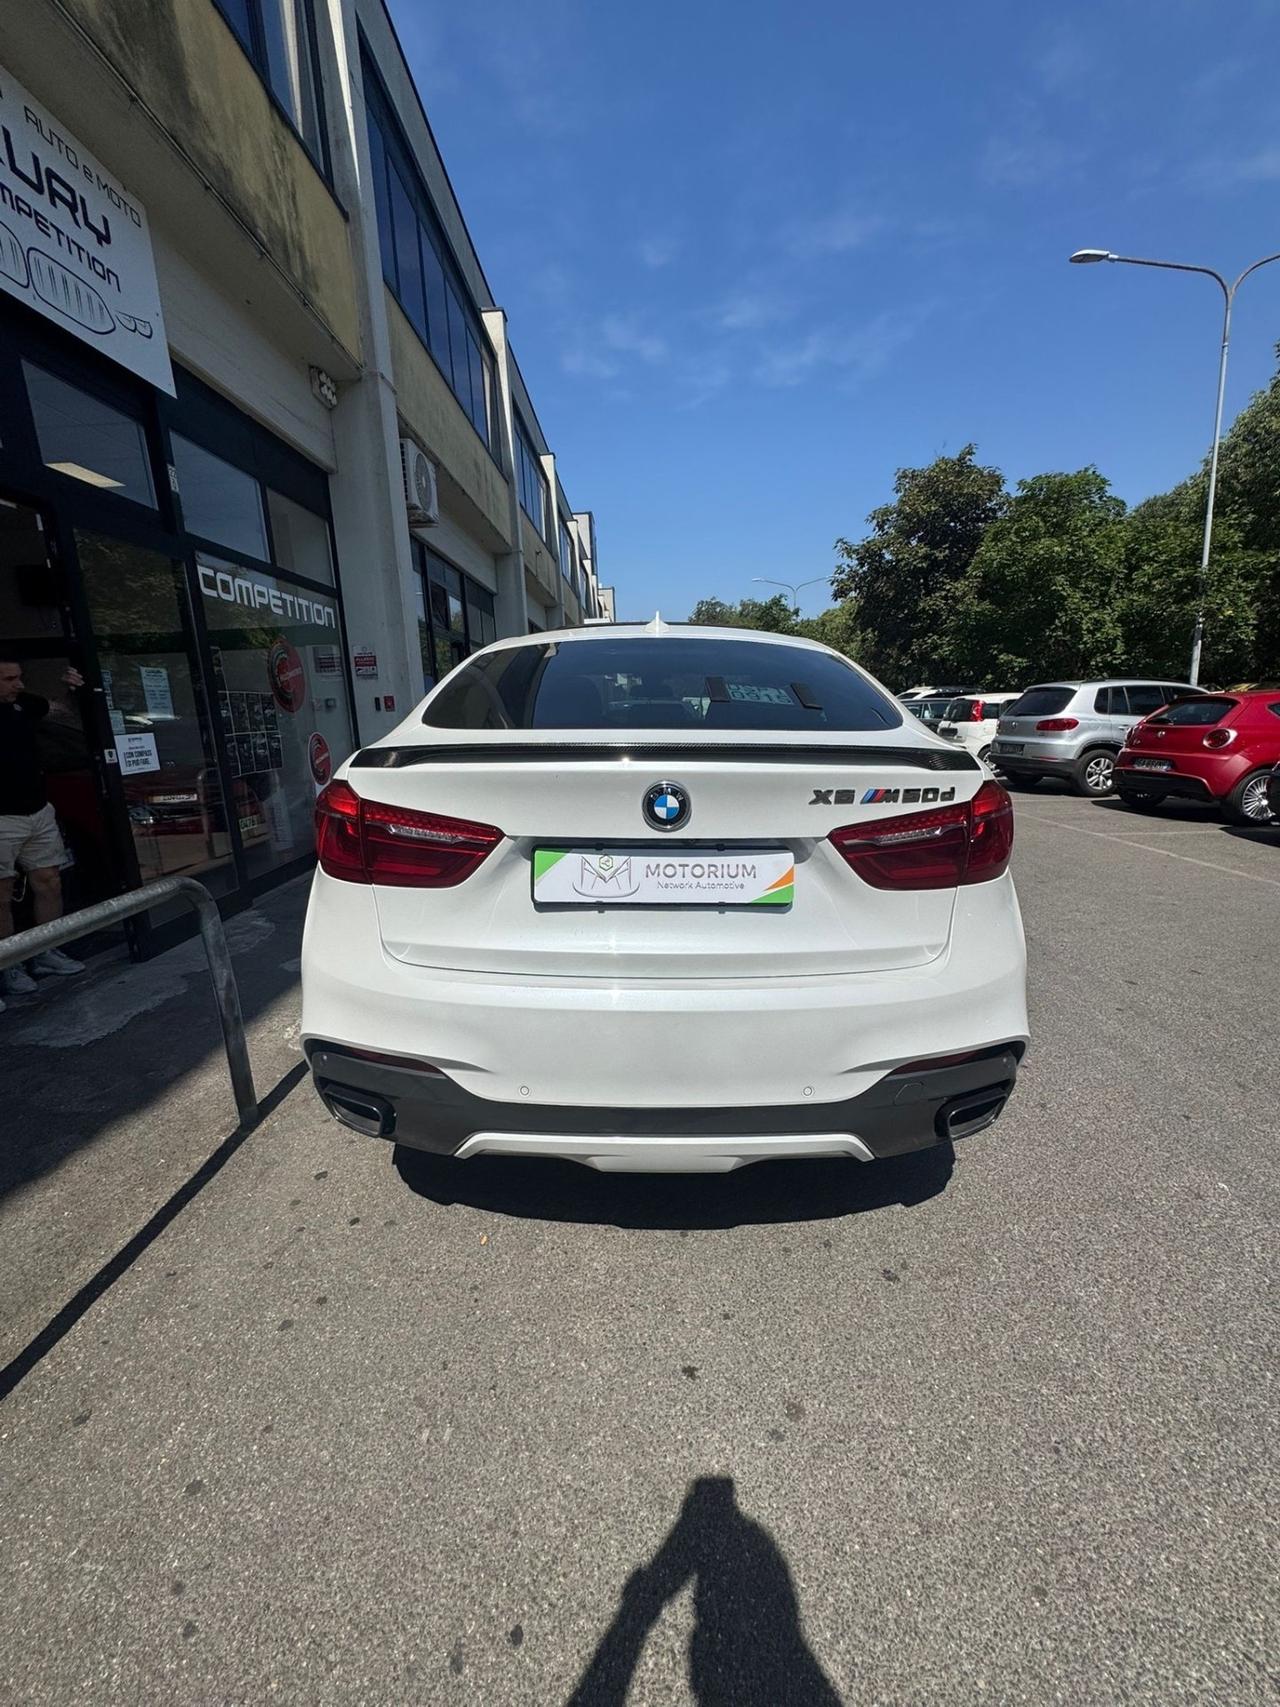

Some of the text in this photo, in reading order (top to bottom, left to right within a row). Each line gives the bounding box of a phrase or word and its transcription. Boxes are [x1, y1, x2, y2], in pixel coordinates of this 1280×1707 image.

[23, 105, 79, 170] AUTO
[96, 175, 142, 229] MOTO
[0, 123, 112, 248] URY
[197, 565, 336, 629] COMPETITION
[650, 786, 684, 801] BMW
[808, 789, 856, 805] X6
[645, 863, 757, 879] MOTORIUM
[657, 881, 745, 890] Network Automotive
